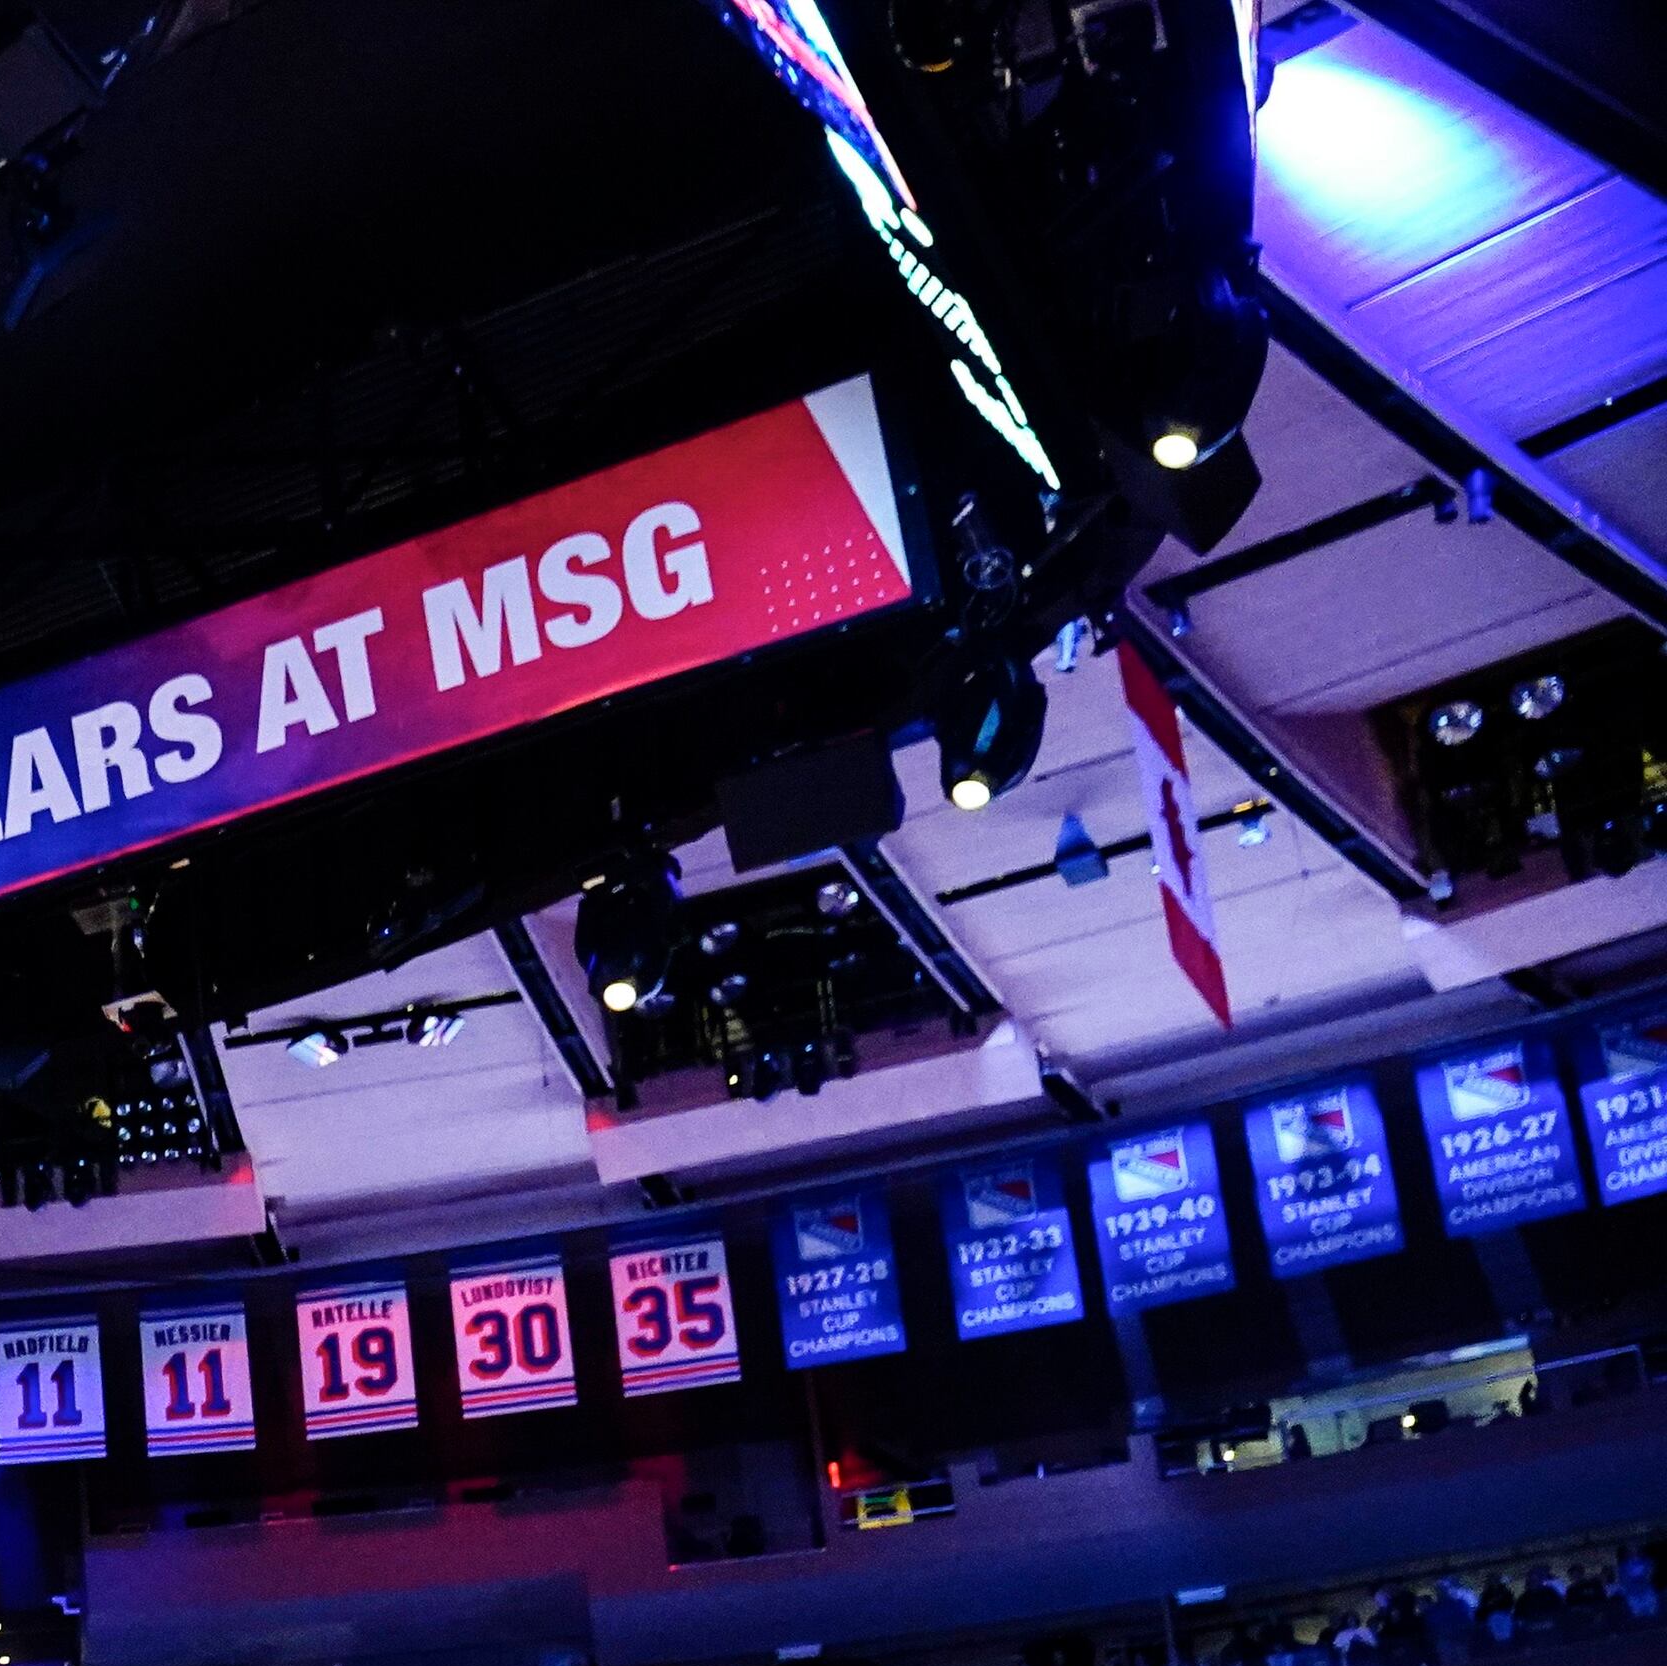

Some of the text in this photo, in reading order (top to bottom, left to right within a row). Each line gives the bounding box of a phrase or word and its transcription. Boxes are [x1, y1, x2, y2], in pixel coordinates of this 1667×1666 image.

[256, 606, 385, 754] AT
[422, 500, 714, 693] MSG
[1440, 1110, 1557, 1159] 1926-27
[626, 1250, 710, 1283] RICHTER
[153, 1322, 232, 1348] MESSIER
[311, 1299, 393, 1329] RATELLE
[464, 1302, 563, 1382] 30
[622, 1275, 726, 1359] 35
[16, 1358, 84, 1430] 11
[162, 1347, 232, 1422] 11
[315, 1326, 399, 1403] 19
